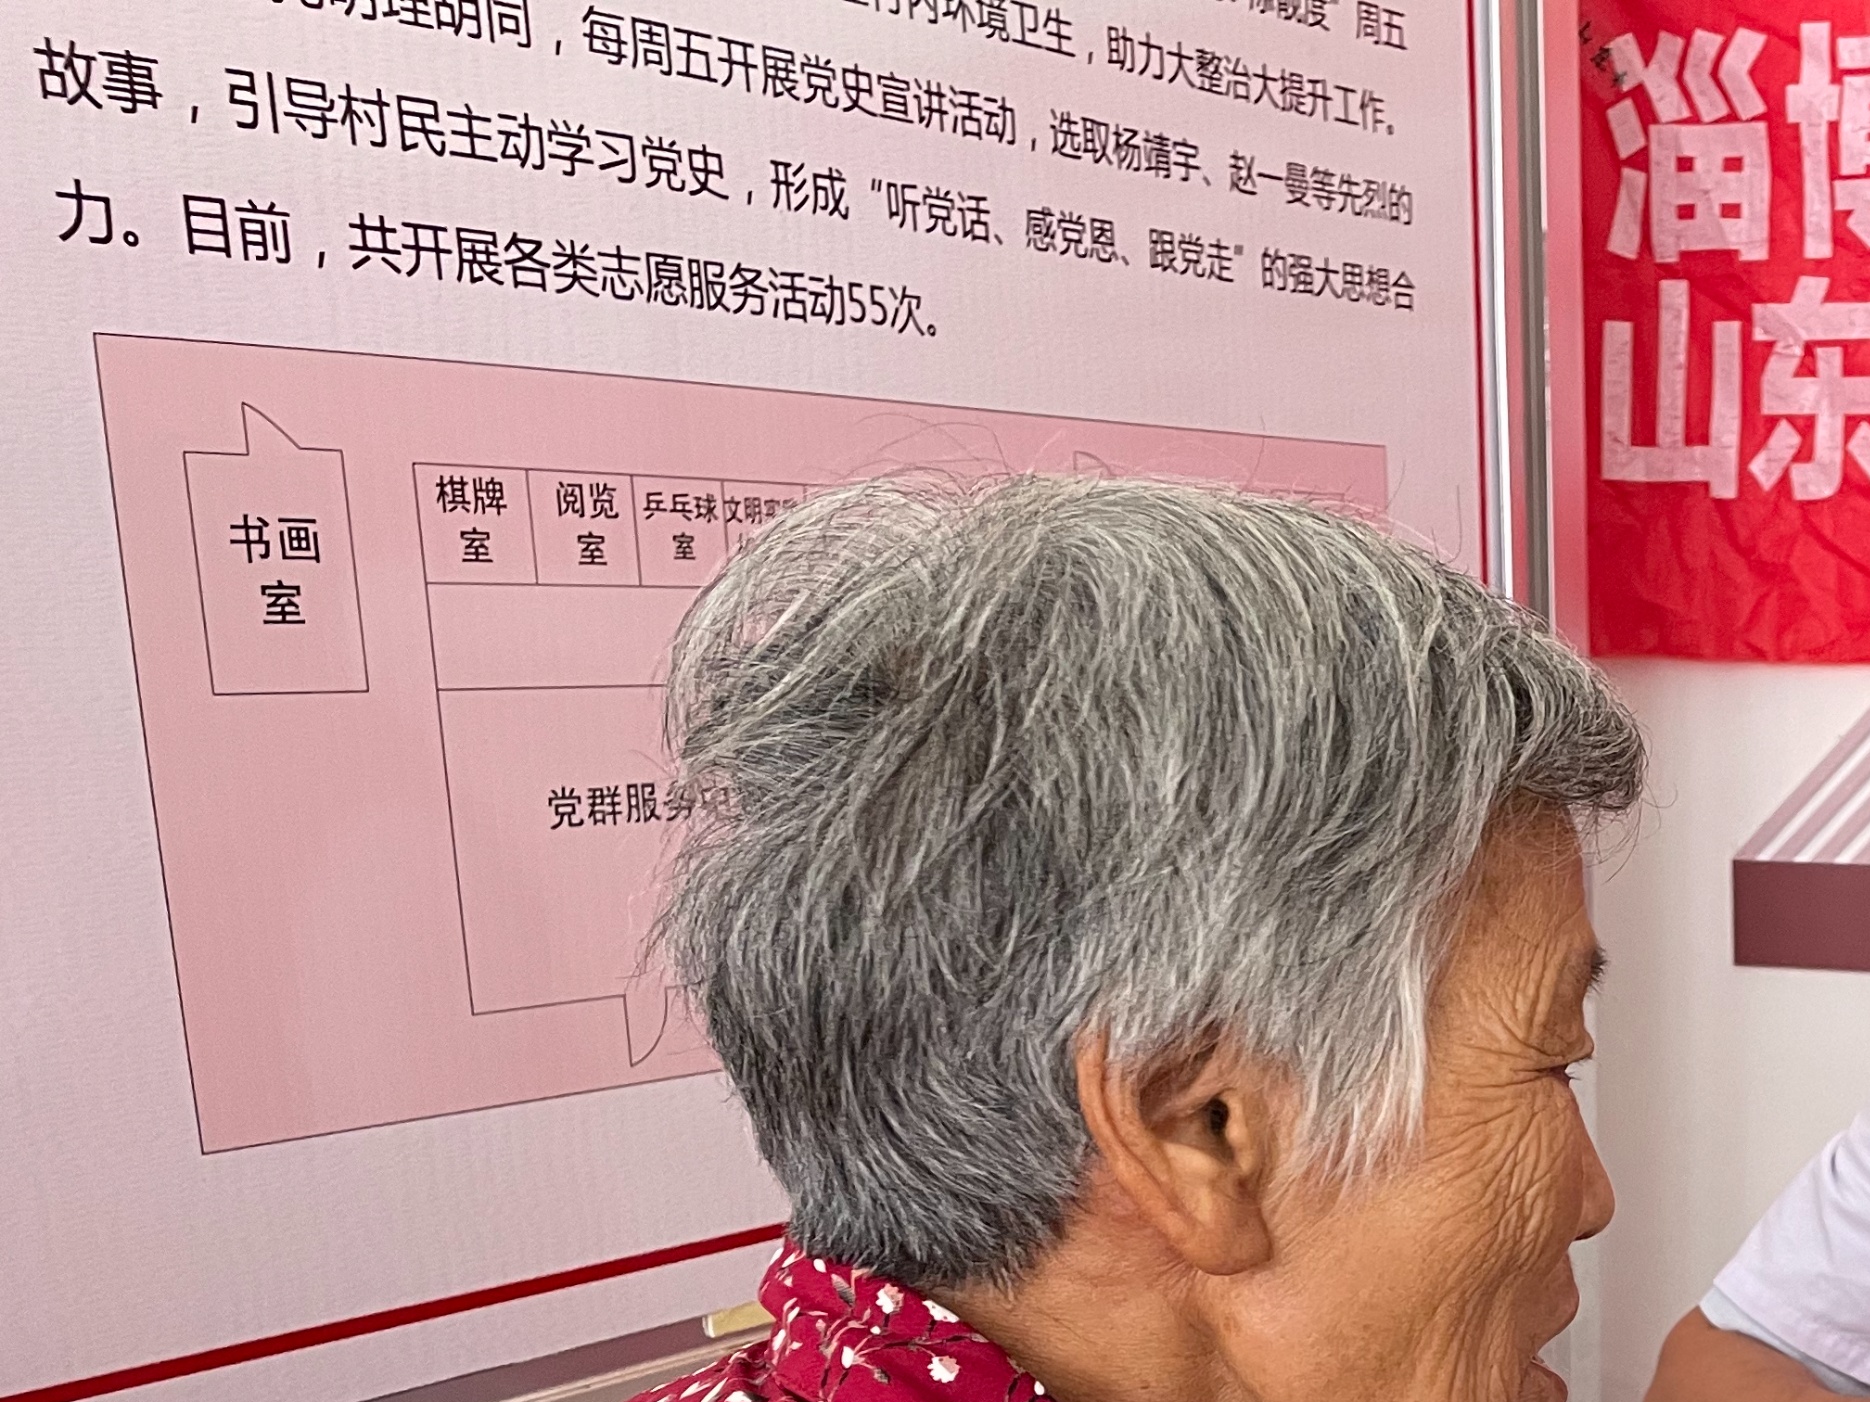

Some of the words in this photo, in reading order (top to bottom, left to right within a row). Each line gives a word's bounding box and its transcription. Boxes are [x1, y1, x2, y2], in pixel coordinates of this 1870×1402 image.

[435, 475, 508, 517] 棋牌
[555, 480, 620, 520] 阅览
[643, 491, 718, 524] 乒乓球
[229, 513, 322, 566] 书画
[460, 526, 495, 564] 室
[576, 531, 608, 567] 室
[672, 532, 697, 561] 室
[260, 579, 307, 626] 室
